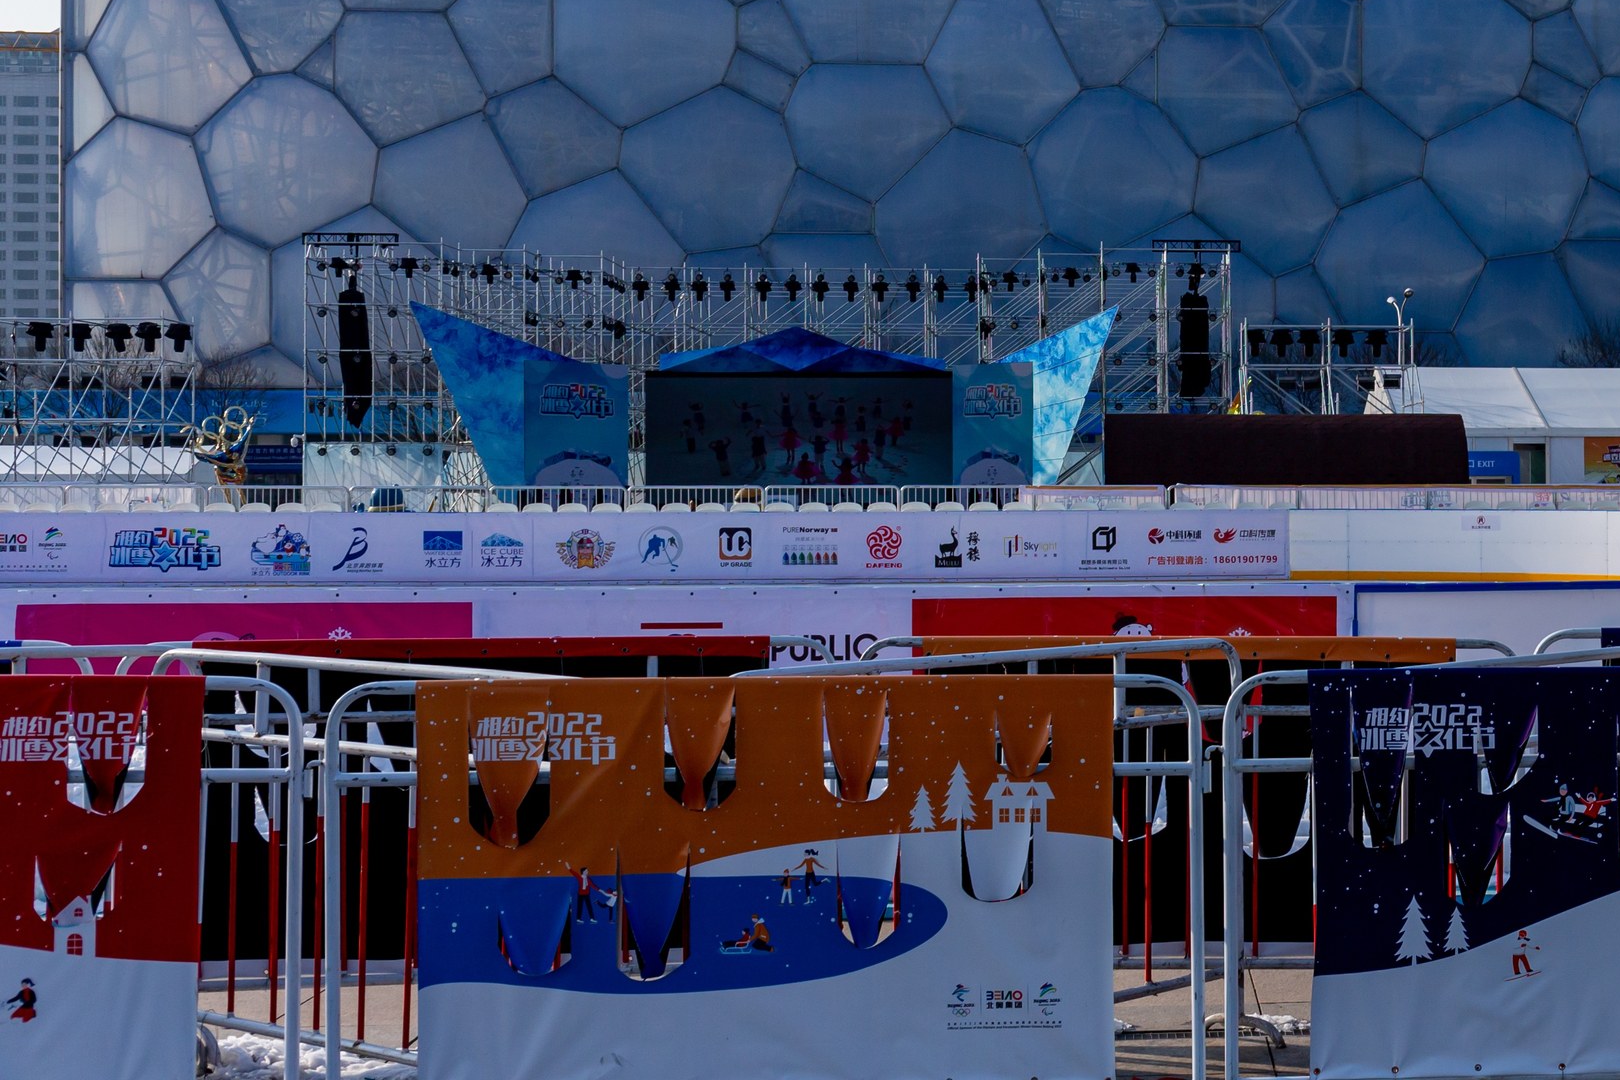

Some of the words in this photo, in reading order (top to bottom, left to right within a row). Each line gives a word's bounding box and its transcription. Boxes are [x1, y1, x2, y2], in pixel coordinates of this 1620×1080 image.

[1477, 460, 1496, 468] EXIT
[115, 527, 210, 546] 相约2022
[109, 540, 221, 572] 冰雪文化节
[425, 557, 461, 568] 水立方
[481, 555, 523, 568] 冰立方
[1213, 555, 1278, 564] 18601901799
[2, 711, 135, 737] 相约2022
[476, 711, 603, 737] 相约2022
[1365, 703, 1483, 727] 相约2022
[470, 729, 617, 767] 冰雪文化节
[1360, 721, 1496, 758] 冰雪文化节
